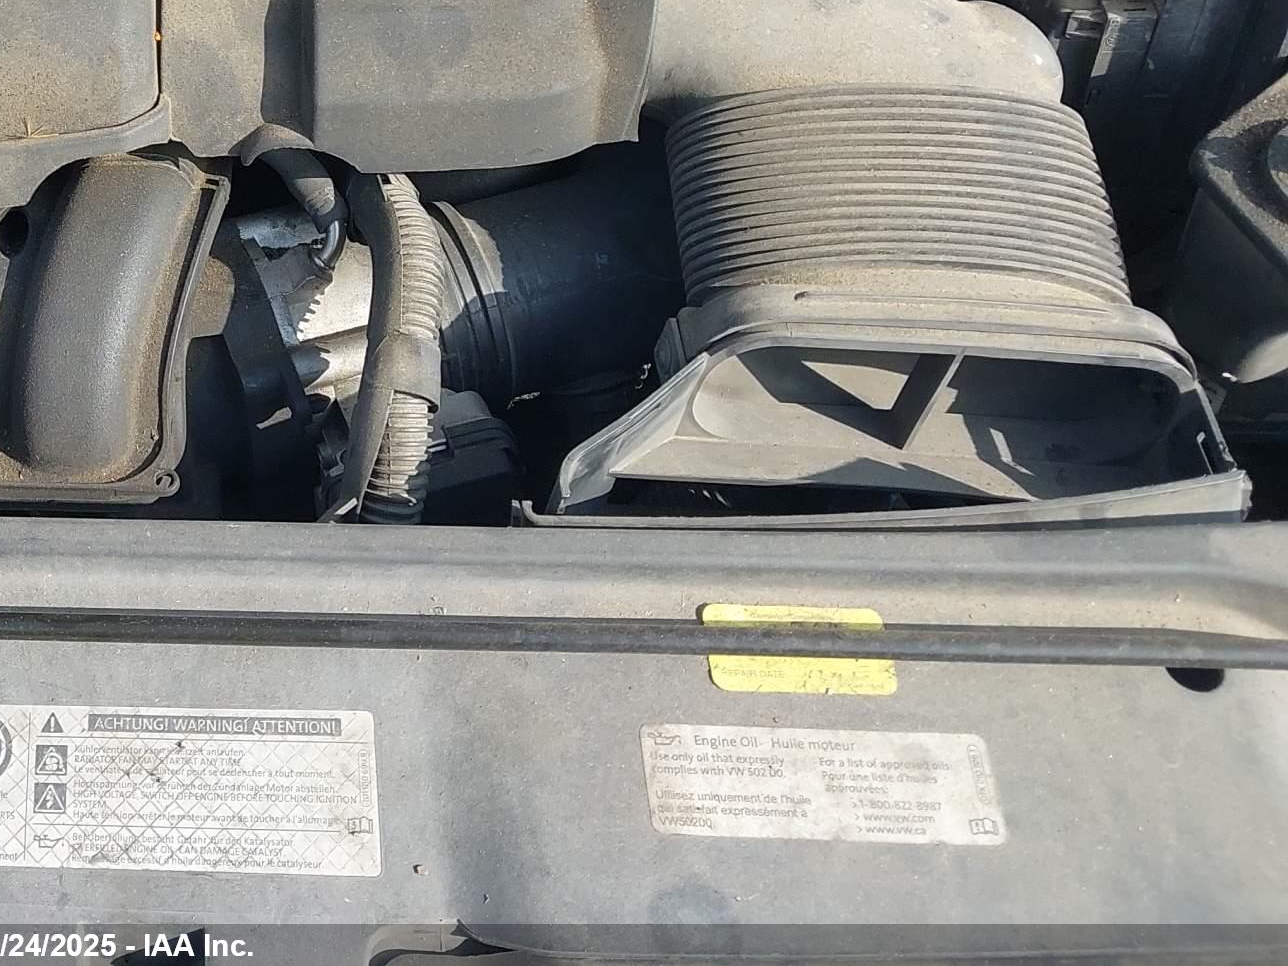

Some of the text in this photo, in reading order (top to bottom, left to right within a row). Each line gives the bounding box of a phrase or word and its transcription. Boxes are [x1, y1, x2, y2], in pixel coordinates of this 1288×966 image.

[94, 717, 337, 735] ACHTUNG! WARNING! ATTENTION!
[694, 735, 855, 752] Engine Oil Huile moteur
[74, 755, 115, 764] RADIATOR
[201, 758, 218, 766] ANY
[650, 751, 785, 767] Use only oil that expressly
[819, 757, 836, 767] For
[847, 758, 864, 768] list
[866, 758, 877, 768] of
[275, 769, 293, 778] tout
[653, 764, 697, 776] complies
[700, 765, 725, 776] with
[727, 766, 745, 776] VW
[748, 766, 767, 777] 502
[822, 771, 846, 781] Pour
[848, 772, 868, 781] une
[872, 772, 894, 783] liste
[266, 784, 293, 793] Motor
[73, 790, 96, 798] HIGH
[140, 791, 174, 800] SWITCH
[231, 793, 263, 802] BEFORE
[266, 794, 314, 803] TOUCHING
[316, 795, 357, 804] IGNITION
[697, 791, 762, 805] uniquement
[764, 793, 777, 804] de
[73, 800, 107, 809] SYSTEM
